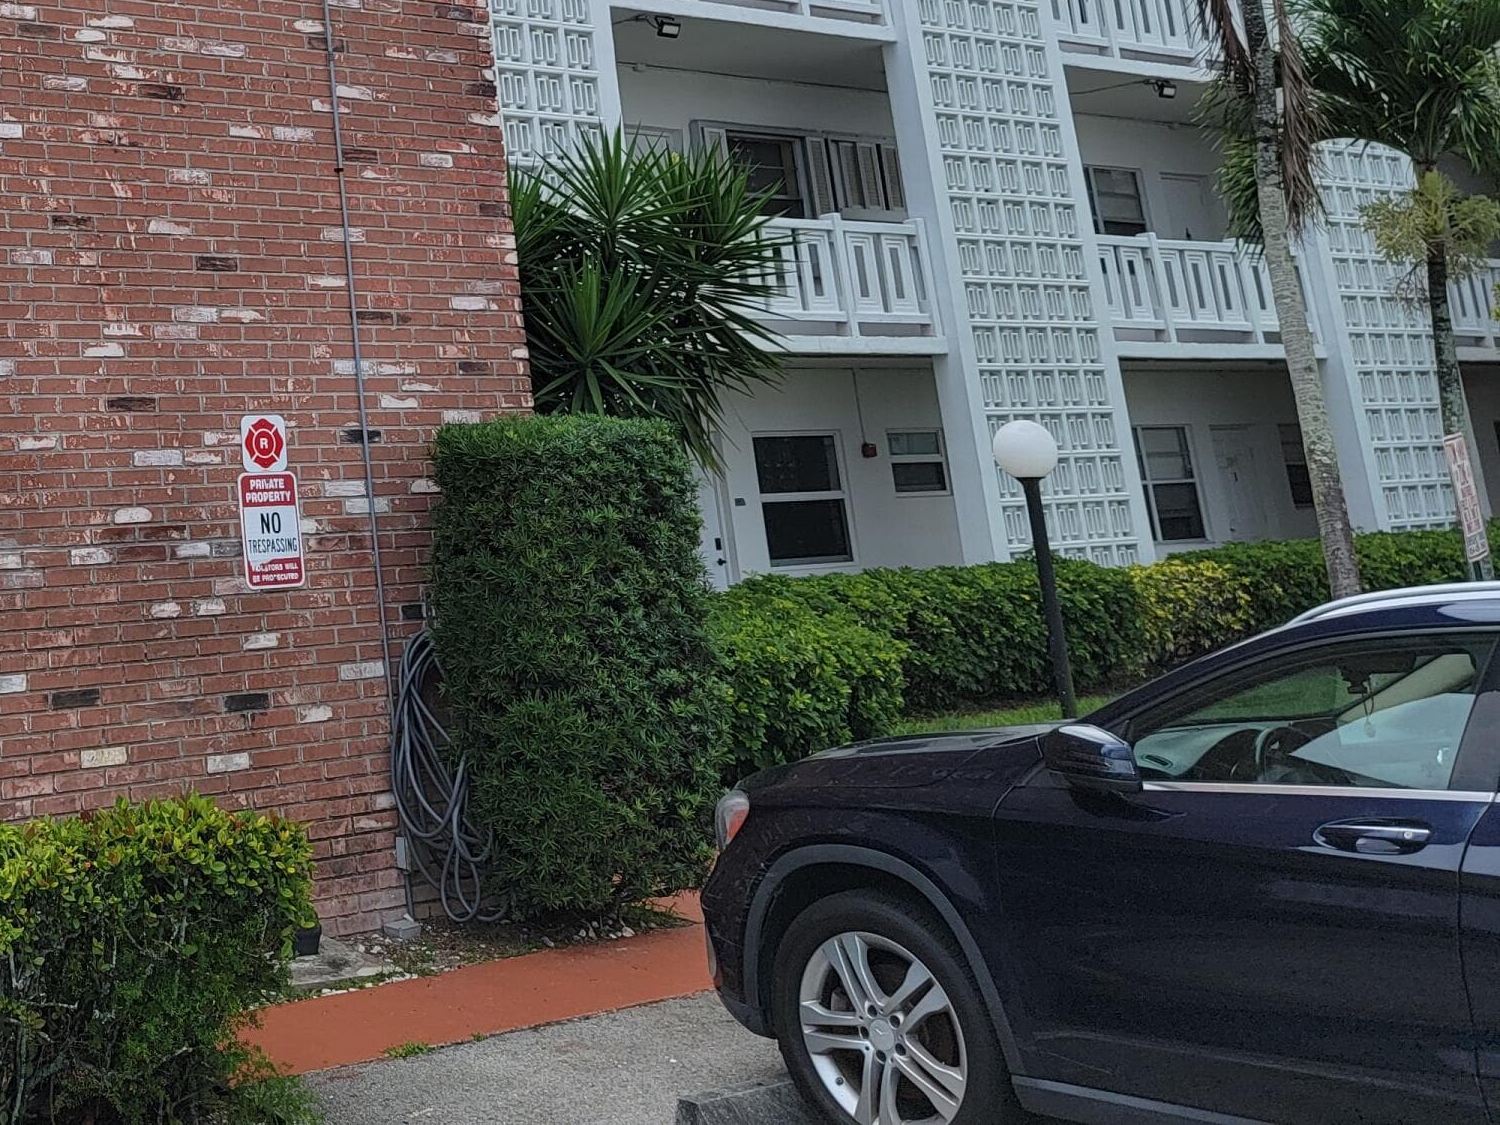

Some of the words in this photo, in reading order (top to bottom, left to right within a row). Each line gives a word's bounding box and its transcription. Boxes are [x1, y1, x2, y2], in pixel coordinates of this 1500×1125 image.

[260, 438, 269, 450] R
[249, 478, 285, 490] PRIVATE
[245, 491, 291, 504] PROPERTY
[260, 511, 282, 535] NO
[248, 537, 298, 555] TRESPASSING
[284, 562, 299, 570] WILL
[252, 575, 261, 583] BE
